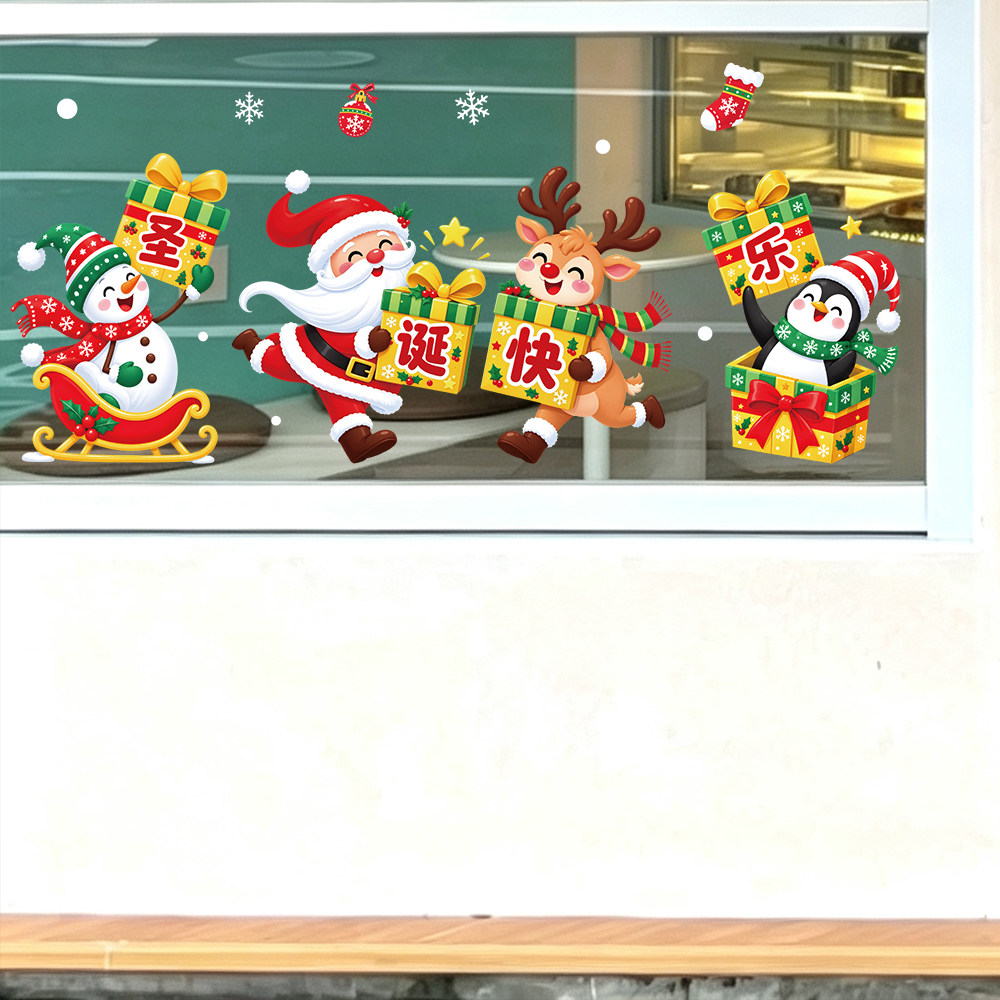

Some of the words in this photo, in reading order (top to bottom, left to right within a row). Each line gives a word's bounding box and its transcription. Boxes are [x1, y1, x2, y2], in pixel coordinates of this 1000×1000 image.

[138, 213, 187, 270] 圣
[397, 320, 450, 377] 诞
[505, 327, 563, 391] 快
[746, 224, 796, 284] 乐
